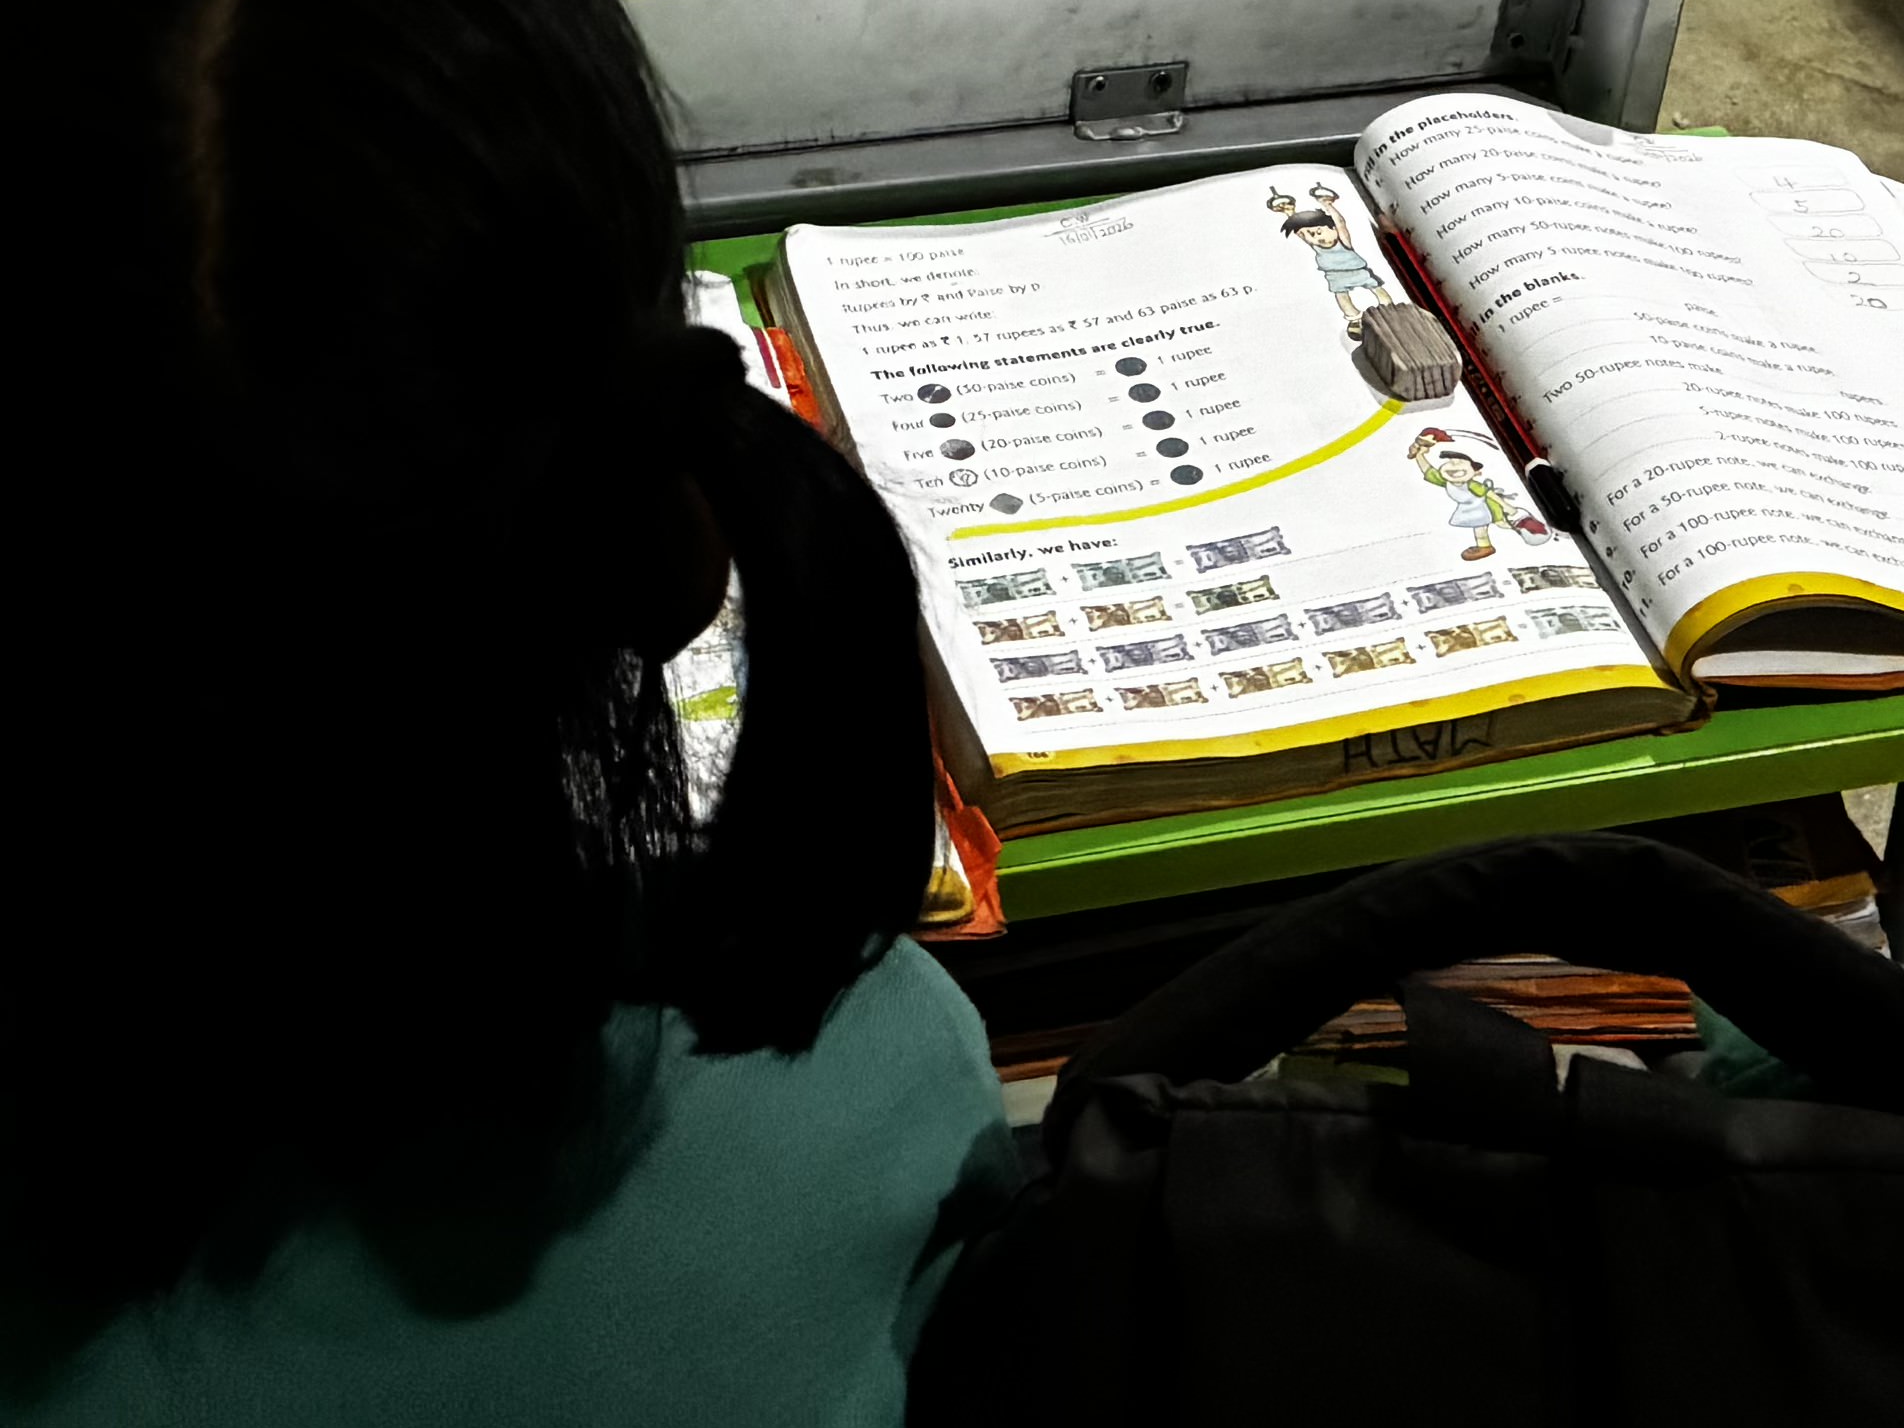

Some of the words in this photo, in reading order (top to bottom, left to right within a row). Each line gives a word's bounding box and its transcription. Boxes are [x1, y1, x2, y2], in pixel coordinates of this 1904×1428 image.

[1374, 143, 1388, 158] in
[1389, 126, 1414, 143] the
[1418, 109, 1519, 131] placeholders.
[1389, 143, 1419, 166] How
[1423, 129, 1461, 145] many
[1404, 165, 1435, 190] How
[1439, 151, 1477, 169] many
[1420, 190, 1450, 215] How
[1454, 175, 1493, 193] many
[1436, 213, 1468, 239] How
[1470, 201, 1509, 220] many
[1514, 195, 1571, 209] 10-paise
[1793, 200, 1809, 214] 5
[1452, 237, 1484, 264] How
[1487, 224, 1526, 243] many
[1530, 220, 1595, 233] 50-rupee
[1811, 226, 1846, 239] 20
[1468, 263, 1500, 290] How
[1504, 248, 1543, 269] many
[1547, 246, 1602, 257] 5-rupee
[1847, 271, 1869, 285] 2
[1479, 307, 1495, 325] in
[1495, 287, 1523, 309] the
[1524, 270, 1585, 293] blanks.
[1509, 299, 1550, 326] rupee
[1850, 294, 1888, 310] 20
[876, 341, 917, 356] rupee
[922, 338, 937, 348] as
[996, 326, 1045, 343] rupees
[1048, 325, 1065, 334] as
[1106, 310, 1134, 324] and
[1138, 307, 1155, 318] 63
[1159, 296, 1197, 314] paise
[1201, 292, 1217, 303] as
[1220, 287, 1239, 299] 63
[870, 369, 905, 381] The
[909, 358, 991, 378] following
[994, 347, 1087, 366] statements
[1092, 342, 1118, 354] are
[1121, 328, 1176, 350] clearly
[1179, 320, 1221, 335] true.
[881, 391, 914, 406] Two
[1029, 370, 1076, 388] coins)
[1171, 345, 1213, 363] rupee
[1542, 380, 1573, 404] Two
[1575, 359, 1642, 384] 50-rupee
[1645, 359, 1685, 369] notes
[892, 417, 925, 433] Four
[1034, 398, 1082, 416] coins)
[1185, 371, 1227, 390] rupee
[1682, 381, 1744, 400] 20-rupee
[1823, 411, 1851, 421] 100
[904, 447, 934, 461] Five
[1056, 426, 1103, 445] coins)
[1199, 398, 1242, 417] rupee
[1699, 406, 1752, 422] 5-rupee
[1832, 434, 1859, 445] 100
[915, 475, 944, 489] Ten
[1060, 455, 1108, 473] coins)
[1214, 425, 1256, 445] rupee
[1715, 431, 1770, 447] 2-rupee
[1849, 460, 1878, 471] 100
[927, 500, 985, 519] Twenty
[1095, 480, 1144, 497] coins)
[1228, 453, 1272, 472] rupee
[1607, 487, 1629, 506] For
[1632, 479, 1642, 489] a
[1645, 456, 1713, 482] 20-rupee
[1623, 513, 1646, 532] For
[1648, 503, 1659, 514] a
[1661, 482, 1731, 508] 50-rupee
[947, 544, 1033, 570] Similarly,
[1037, 543, 1066, 555] we
[1068, 536, 1118, 551] have:
[1640, 539, 1663, 559] For
[1665, 529, 1676, 541] a
[1678, 507, 1757, 533] 100-rupee
[1657, 566, 1681, 586] For
[1683, 556, 1694, 568] a
[1696, 533, 1777, 560] 100-rupee
